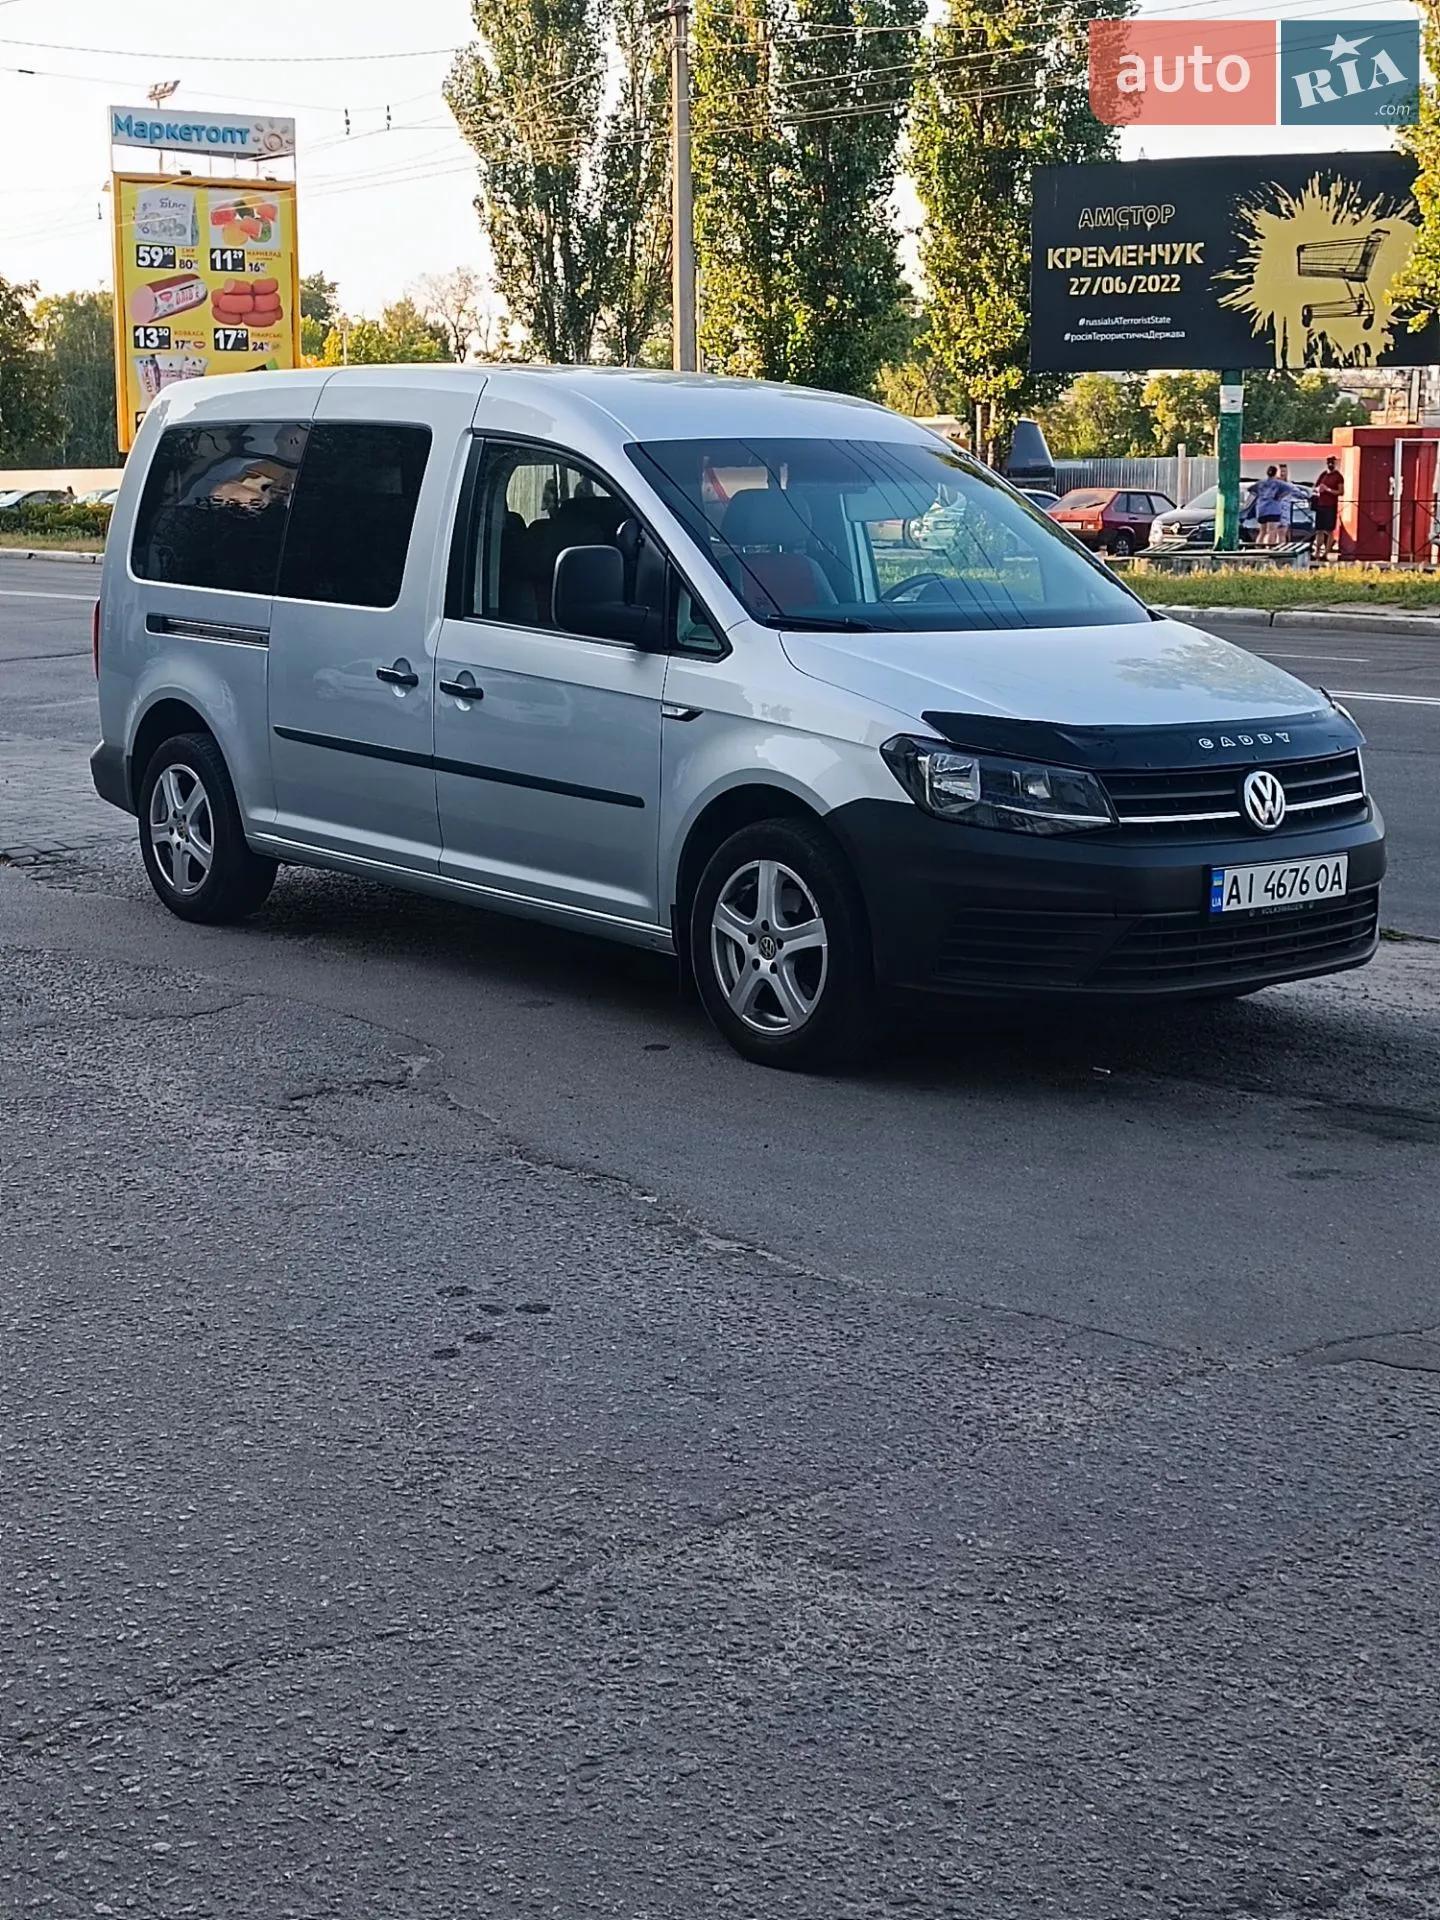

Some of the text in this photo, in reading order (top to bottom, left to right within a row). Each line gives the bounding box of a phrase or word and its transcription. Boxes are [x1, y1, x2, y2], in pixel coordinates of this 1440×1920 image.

[113, 112, 250, 145] Маркетопт
[1078, 204, 1176, 230] АМСТОР
[137, 245, 164, 267] 59
[211, 250, 232, 271] 11
[1047, 242, 1205, 270] КРЕМЕНЧУК
[1068, 273, 1181, 296] 27/06/2022
[135, 327, 159, 348] 13
[215, 329, 237, 350] 17
[1198, 732, 1291, 749] CADDY
[1226, 861, 1343, 906] AI 4676 OA
